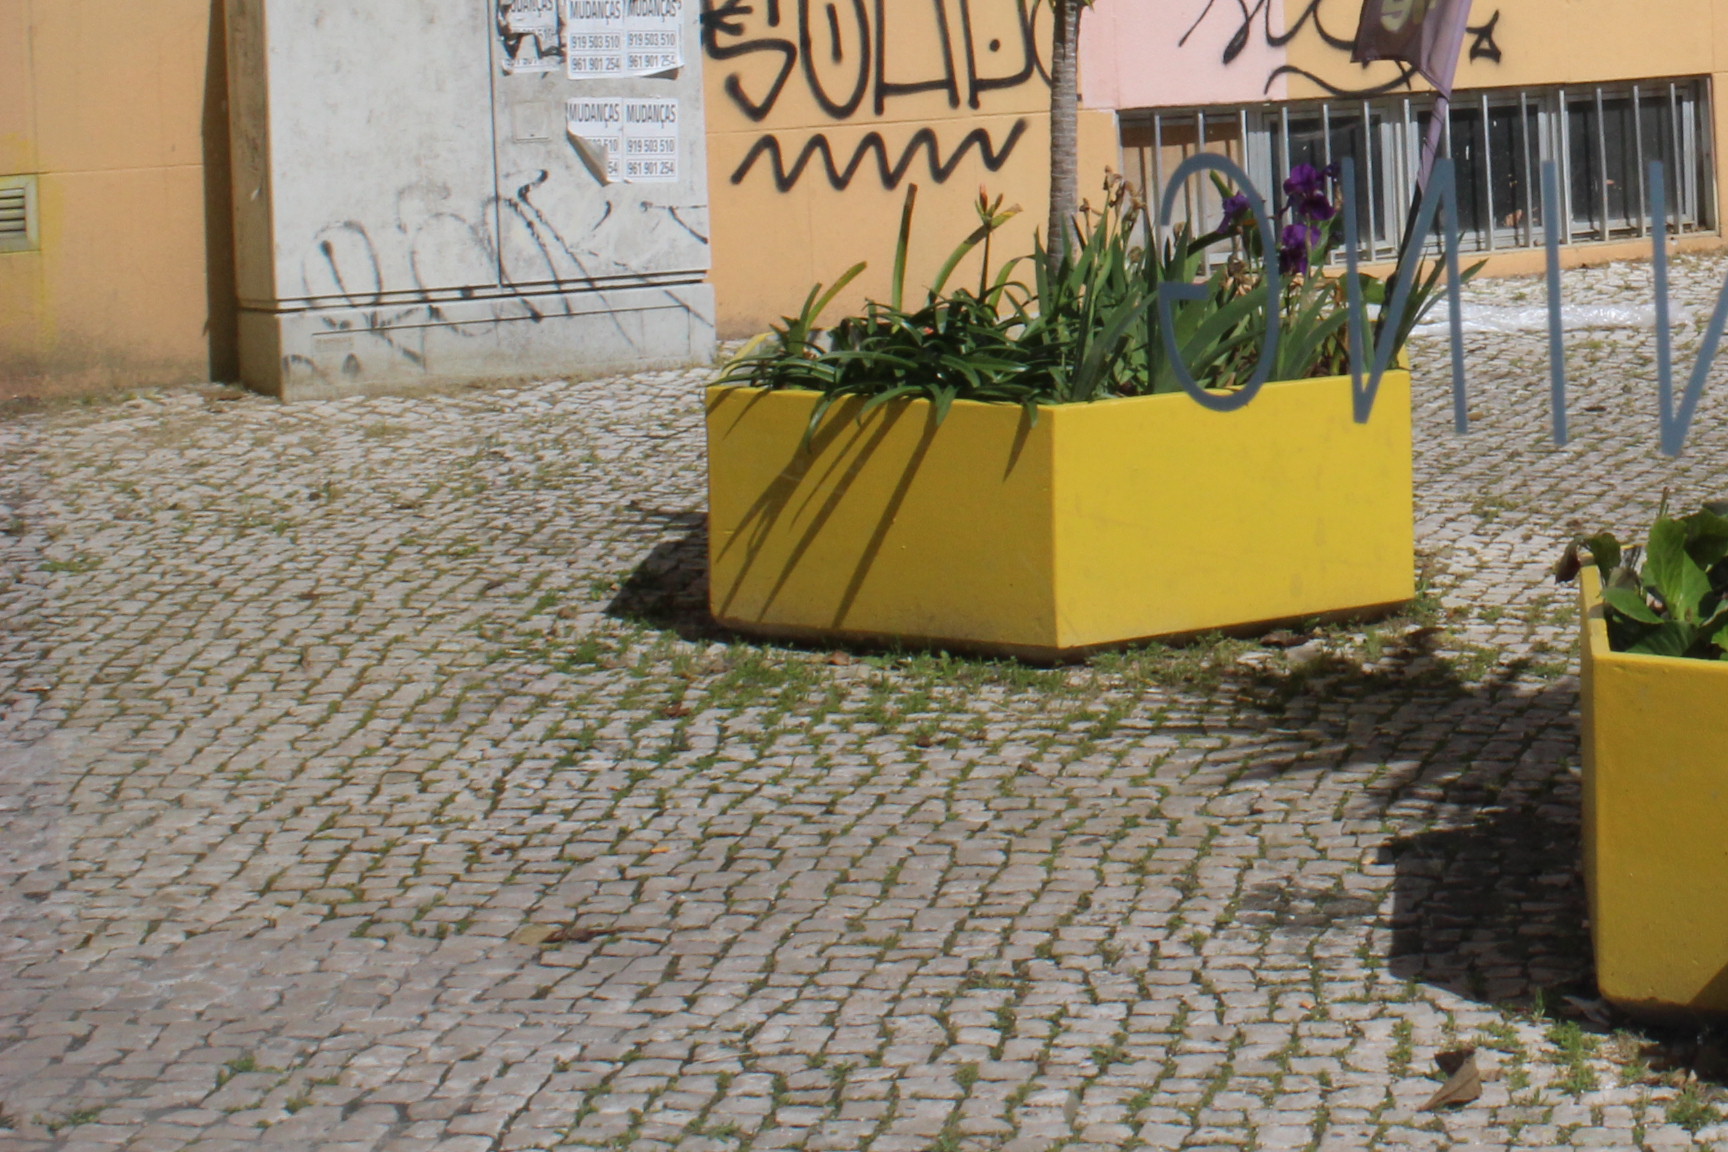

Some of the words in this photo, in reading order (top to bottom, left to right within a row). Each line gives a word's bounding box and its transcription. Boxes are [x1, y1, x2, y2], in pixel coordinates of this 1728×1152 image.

[570, 0, 621, 25] MUDANÇAS
[627, 0, 677, 22] MUDANÇAS
[572, 34, 587, 48] 919
[589, 34, 603, 48] 503
[605, 34, 620, 48] 510
[629, 32, 643, 46] 919
[645, 32, 659, 46] 503
[660, 32, 675, 46] 510
[572, 56, 587, 71] 961
[589, 56, 603, 71] 901
[605, 56, 620, 71] 254
[628, 55, 643, 68] 961
[644, 54, 659, 68] 901
[569, 103, 619, 128] MUDANÇAS
[626, 104, 676, 128] MUDANÇAS
[628, 139, 642, 152] 919
[643, 139, 658, 152] 503
[660, 139, 675, 152] 510
[628, 161, 642, 174] 961
[644, 161, 657, 174] 901
[660, 161, 674, 174] 254
